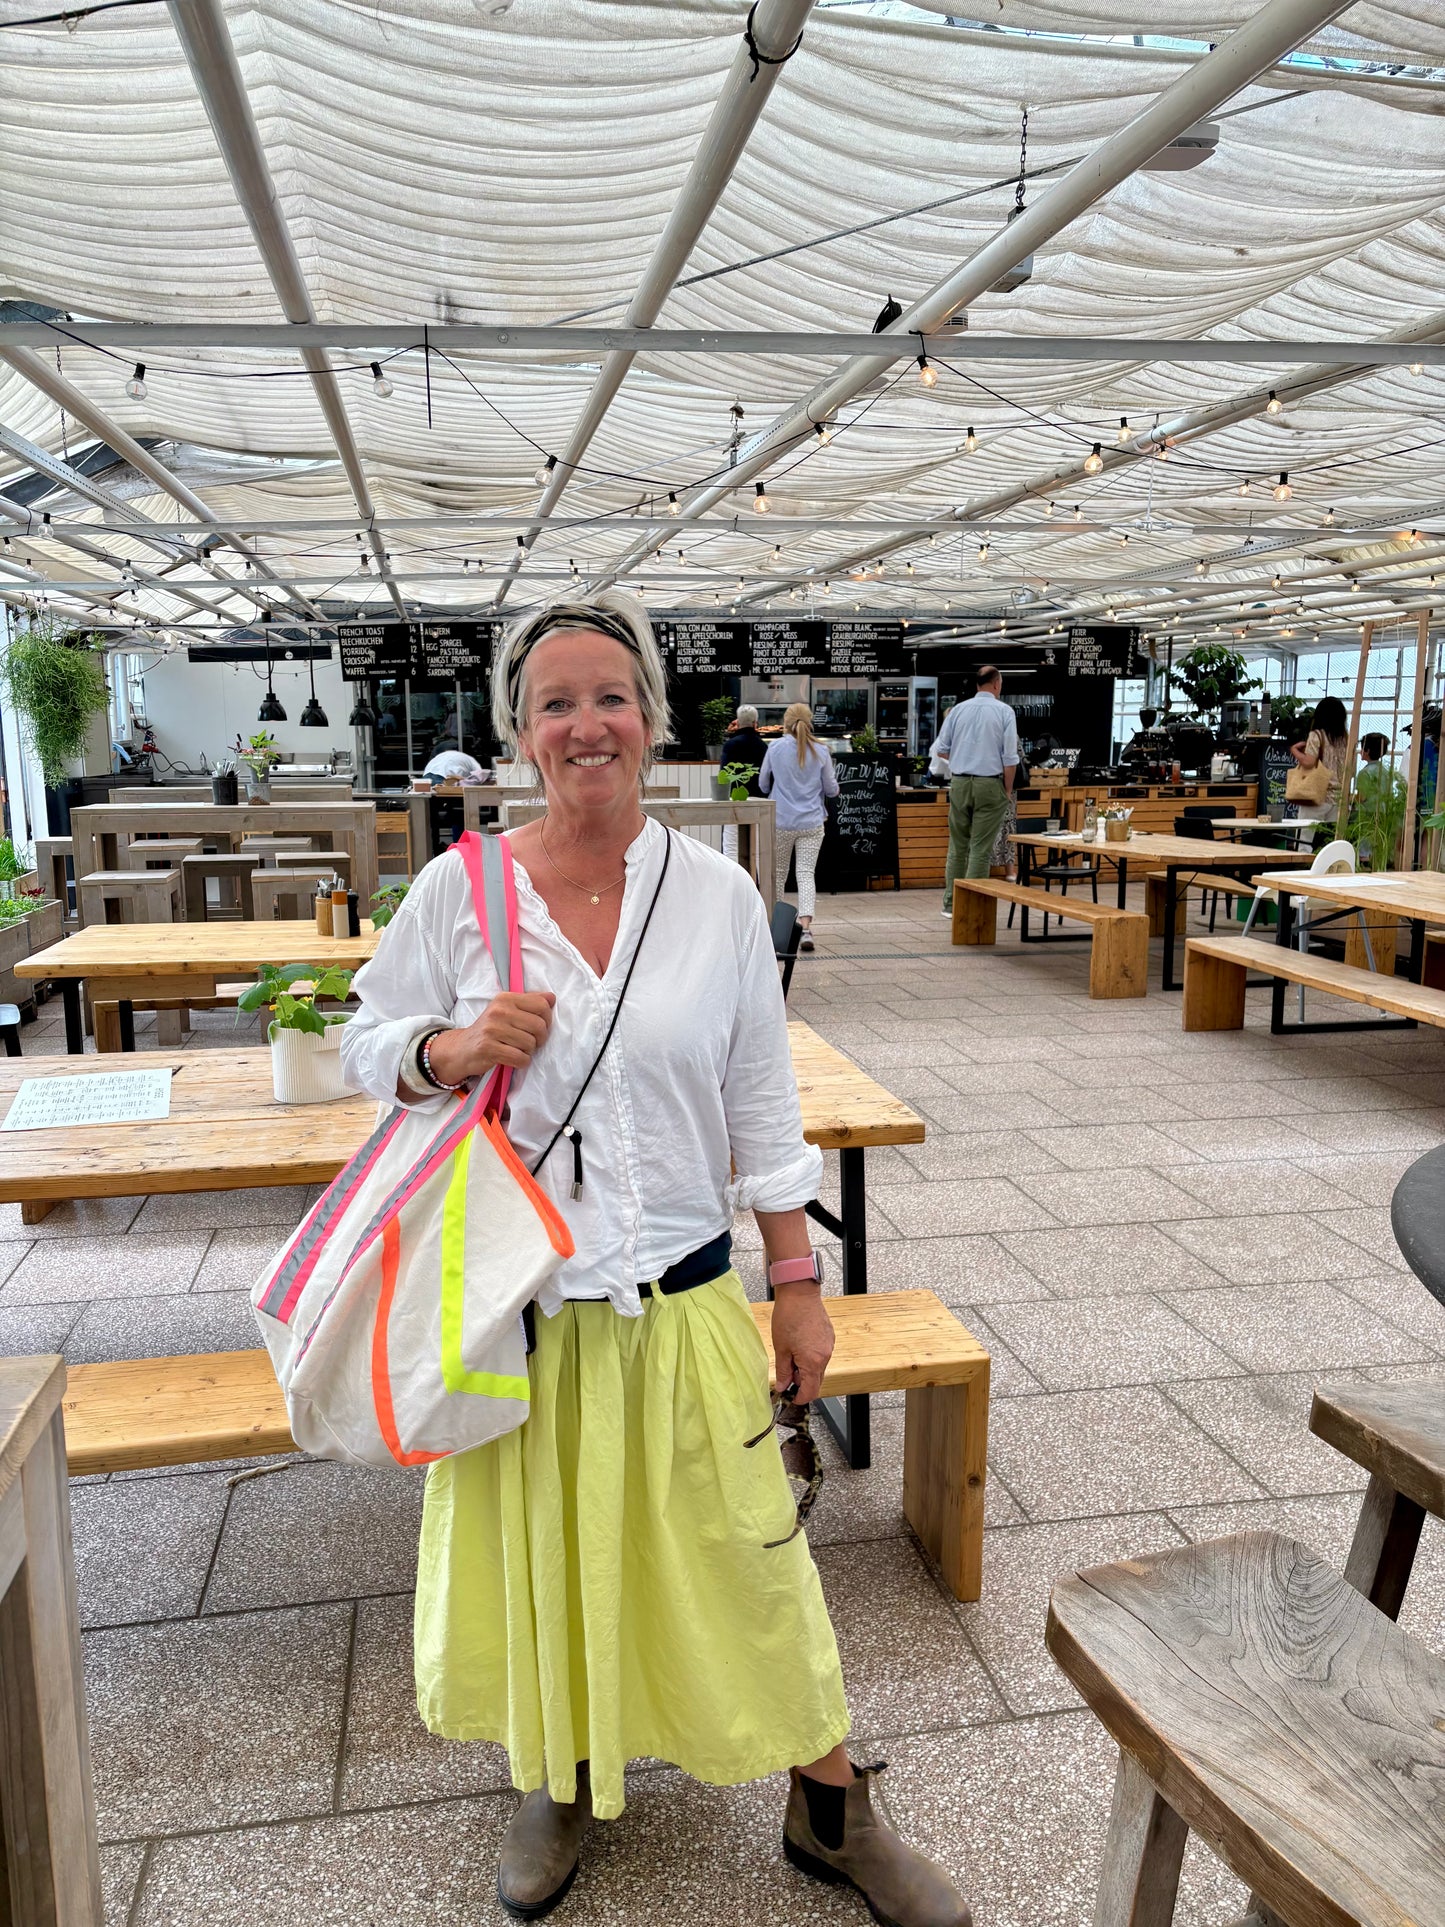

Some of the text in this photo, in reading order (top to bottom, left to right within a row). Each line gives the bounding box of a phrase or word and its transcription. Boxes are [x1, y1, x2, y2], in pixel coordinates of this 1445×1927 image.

[340, 625, 416, 636] FRENCH TOAST 14
[341, 637, 383, 646] BLECHKUCHEN
[342, 645, 417, 656] PORRIDG 12
[344, 657, 375, 665] CROISSANT
[411, 667, 416, 675] 6
[860, 764, 871, 778] DU
